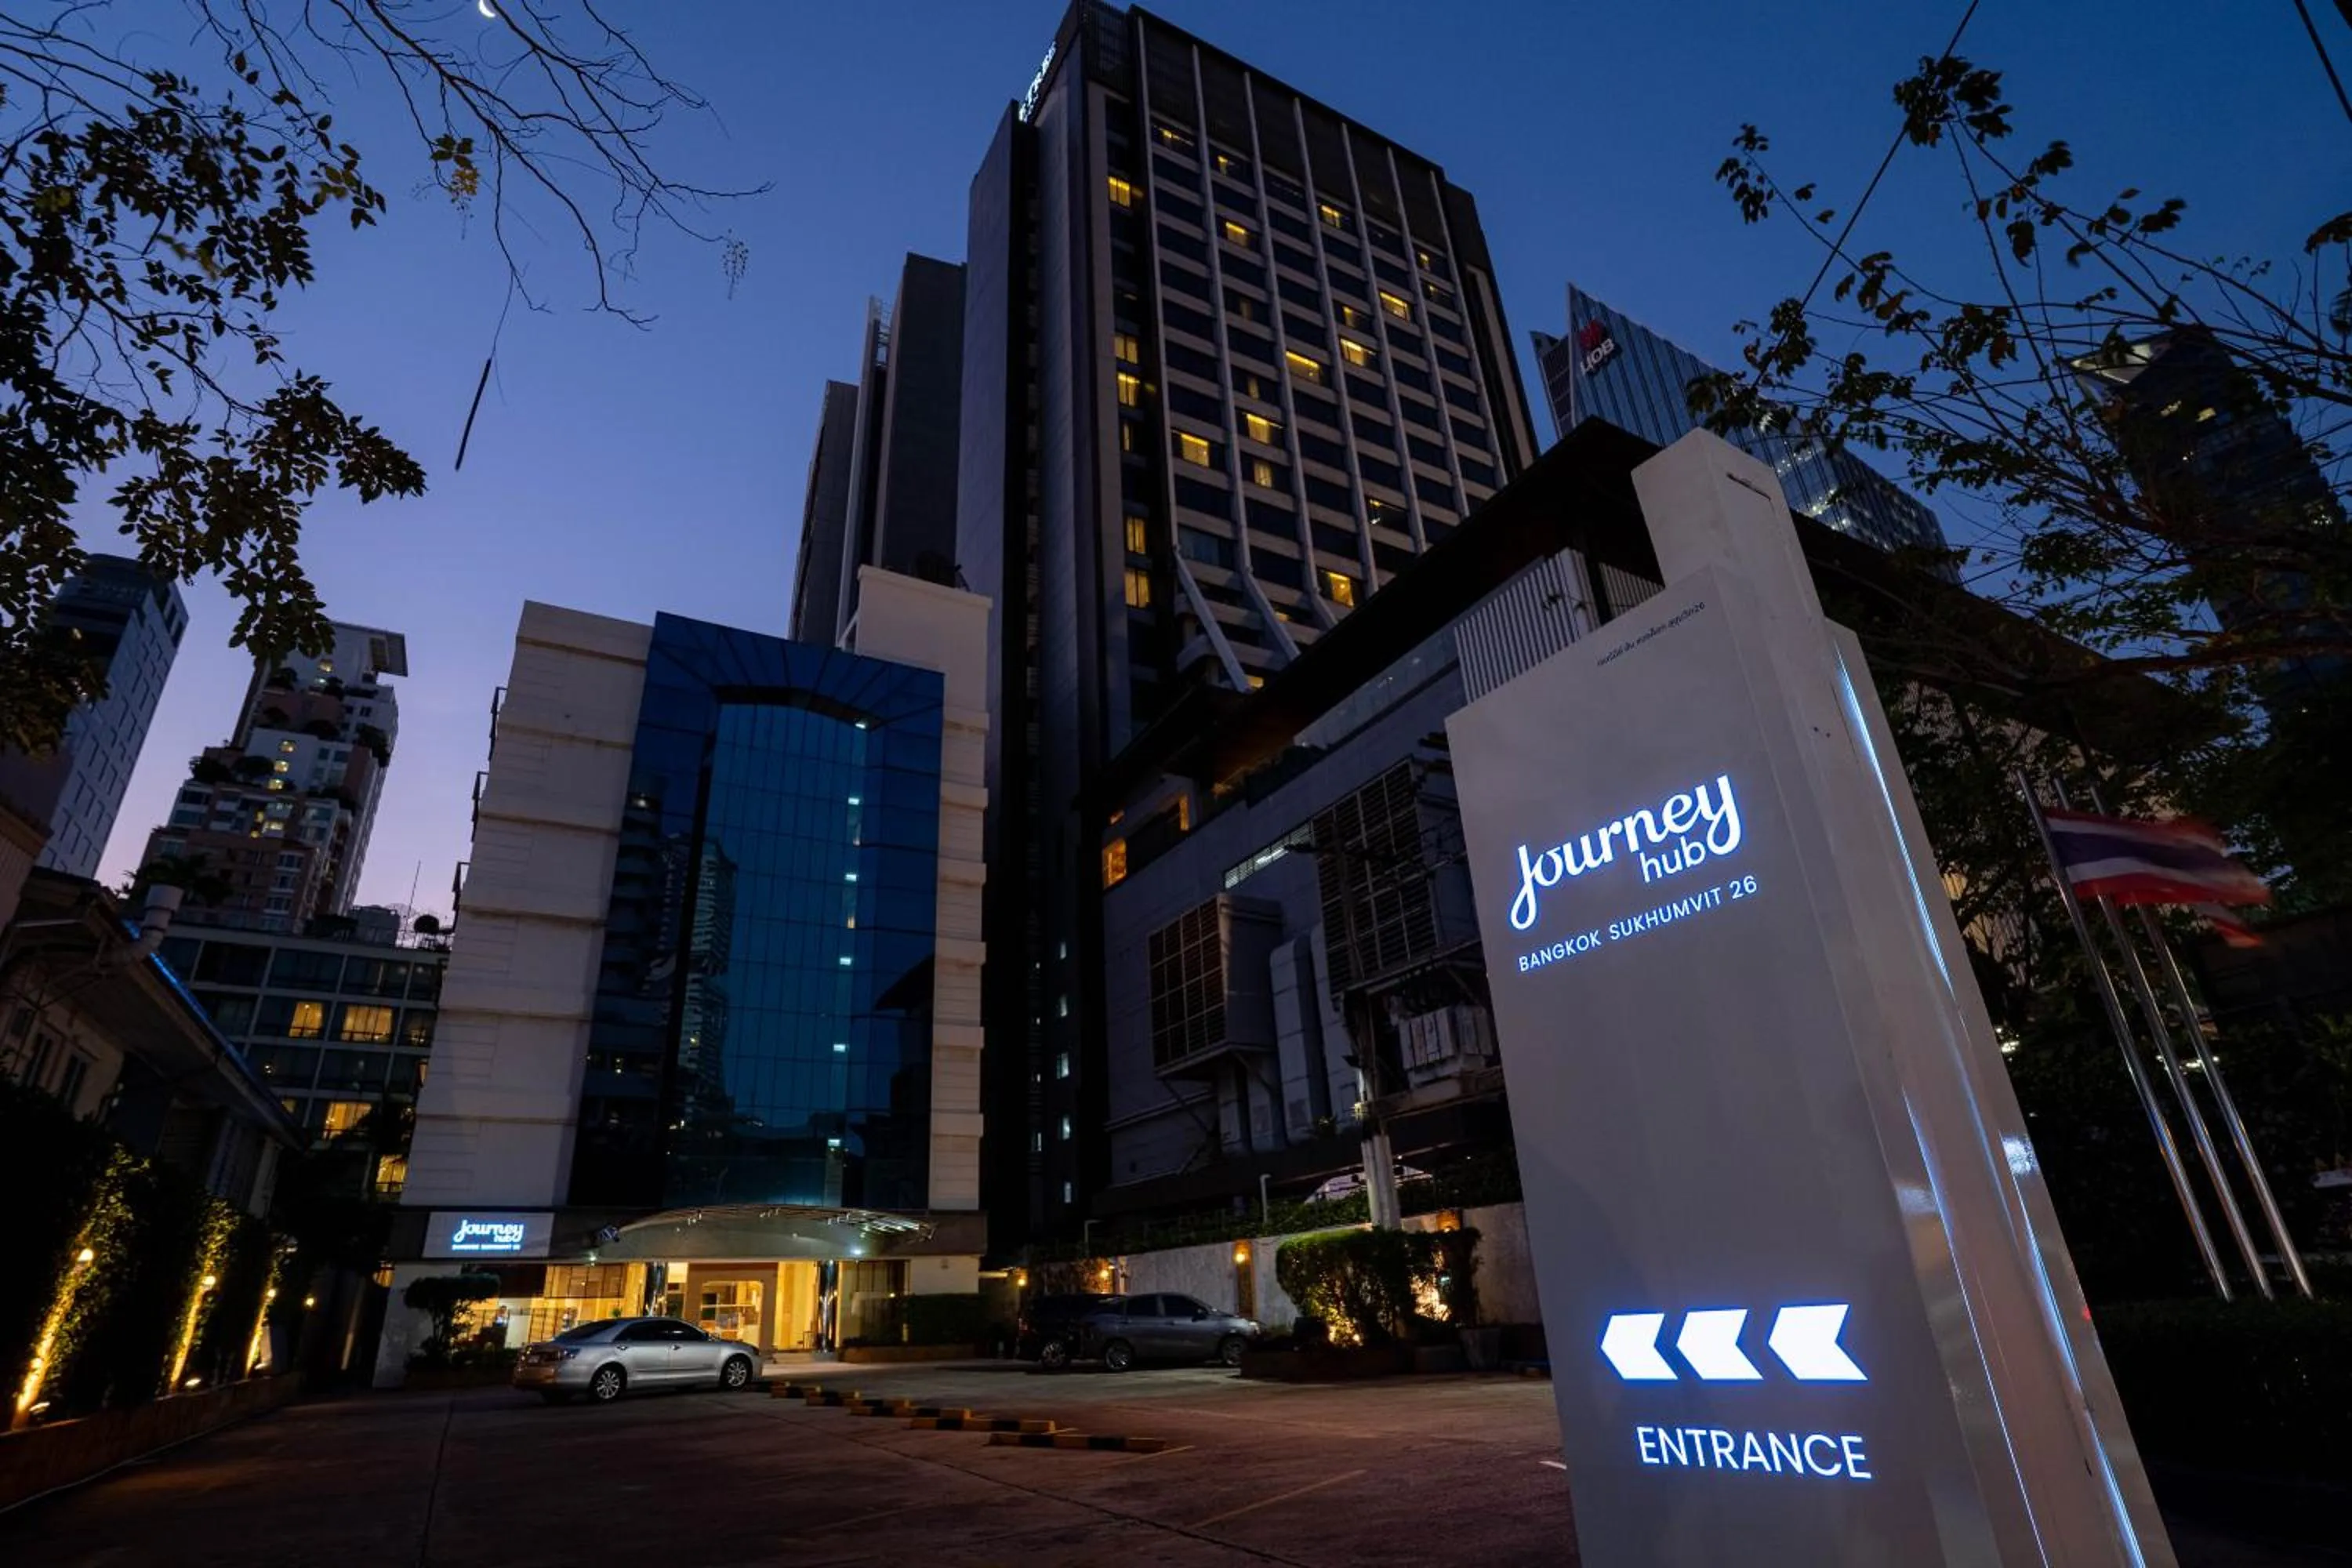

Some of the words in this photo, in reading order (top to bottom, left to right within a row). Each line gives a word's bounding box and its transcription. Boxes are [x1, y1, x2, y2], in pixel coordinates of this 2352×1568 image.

[1580, 338, 1615, 375] UOB
[1639, 836, 1706, 883] hub
[1518, 930, 1602, 971] BANGKOK
[1609, 887, 1722, 940] SUKHUMVIT
[1729, 876, 1757, 899] 26
[1636, 1426, 1872, 1479] ENTRANCE
